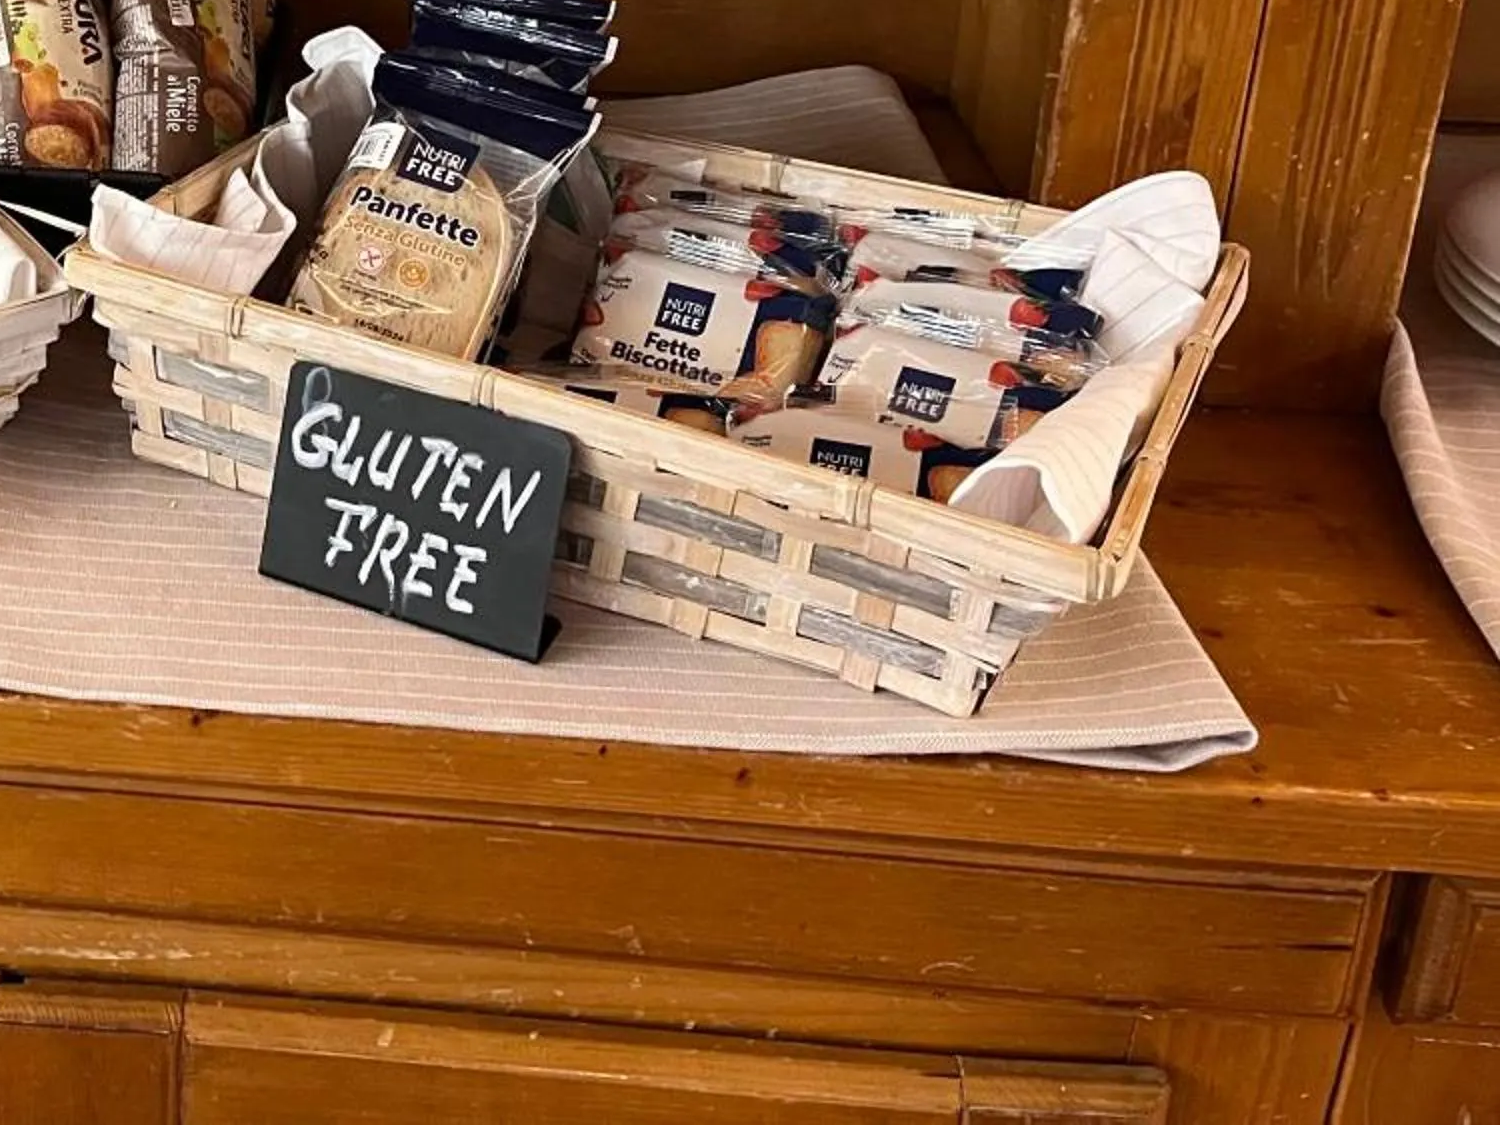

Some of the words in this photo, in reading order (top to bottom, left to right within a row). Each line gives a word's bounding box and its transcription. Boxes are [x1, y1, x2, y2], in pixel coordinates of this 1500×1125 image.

[165, 87, 188, 133] Miele
[187, 75, 201, 133] Cornetto
[405, 158, 461, 187] FREE
[413, 142, 468, 171] NUTRI
[350, 186, 479, 247] Panfette
[343, 214, 393, 242] Senza
[399, 230, 466, 267] Glutine
[661, 310, 703, 331] FREE
[665, 297, 708, 318] NUTRI
[610, 340, 723, 386] Biscottate
[643, 330, 701, 362] Fette
[895, 394, 941, 417] FREE
[291, 402, 541, 535] GLUTEN
[817, 450, 864, 468] NUTRI
[324, 496, 488, 614] FREE
